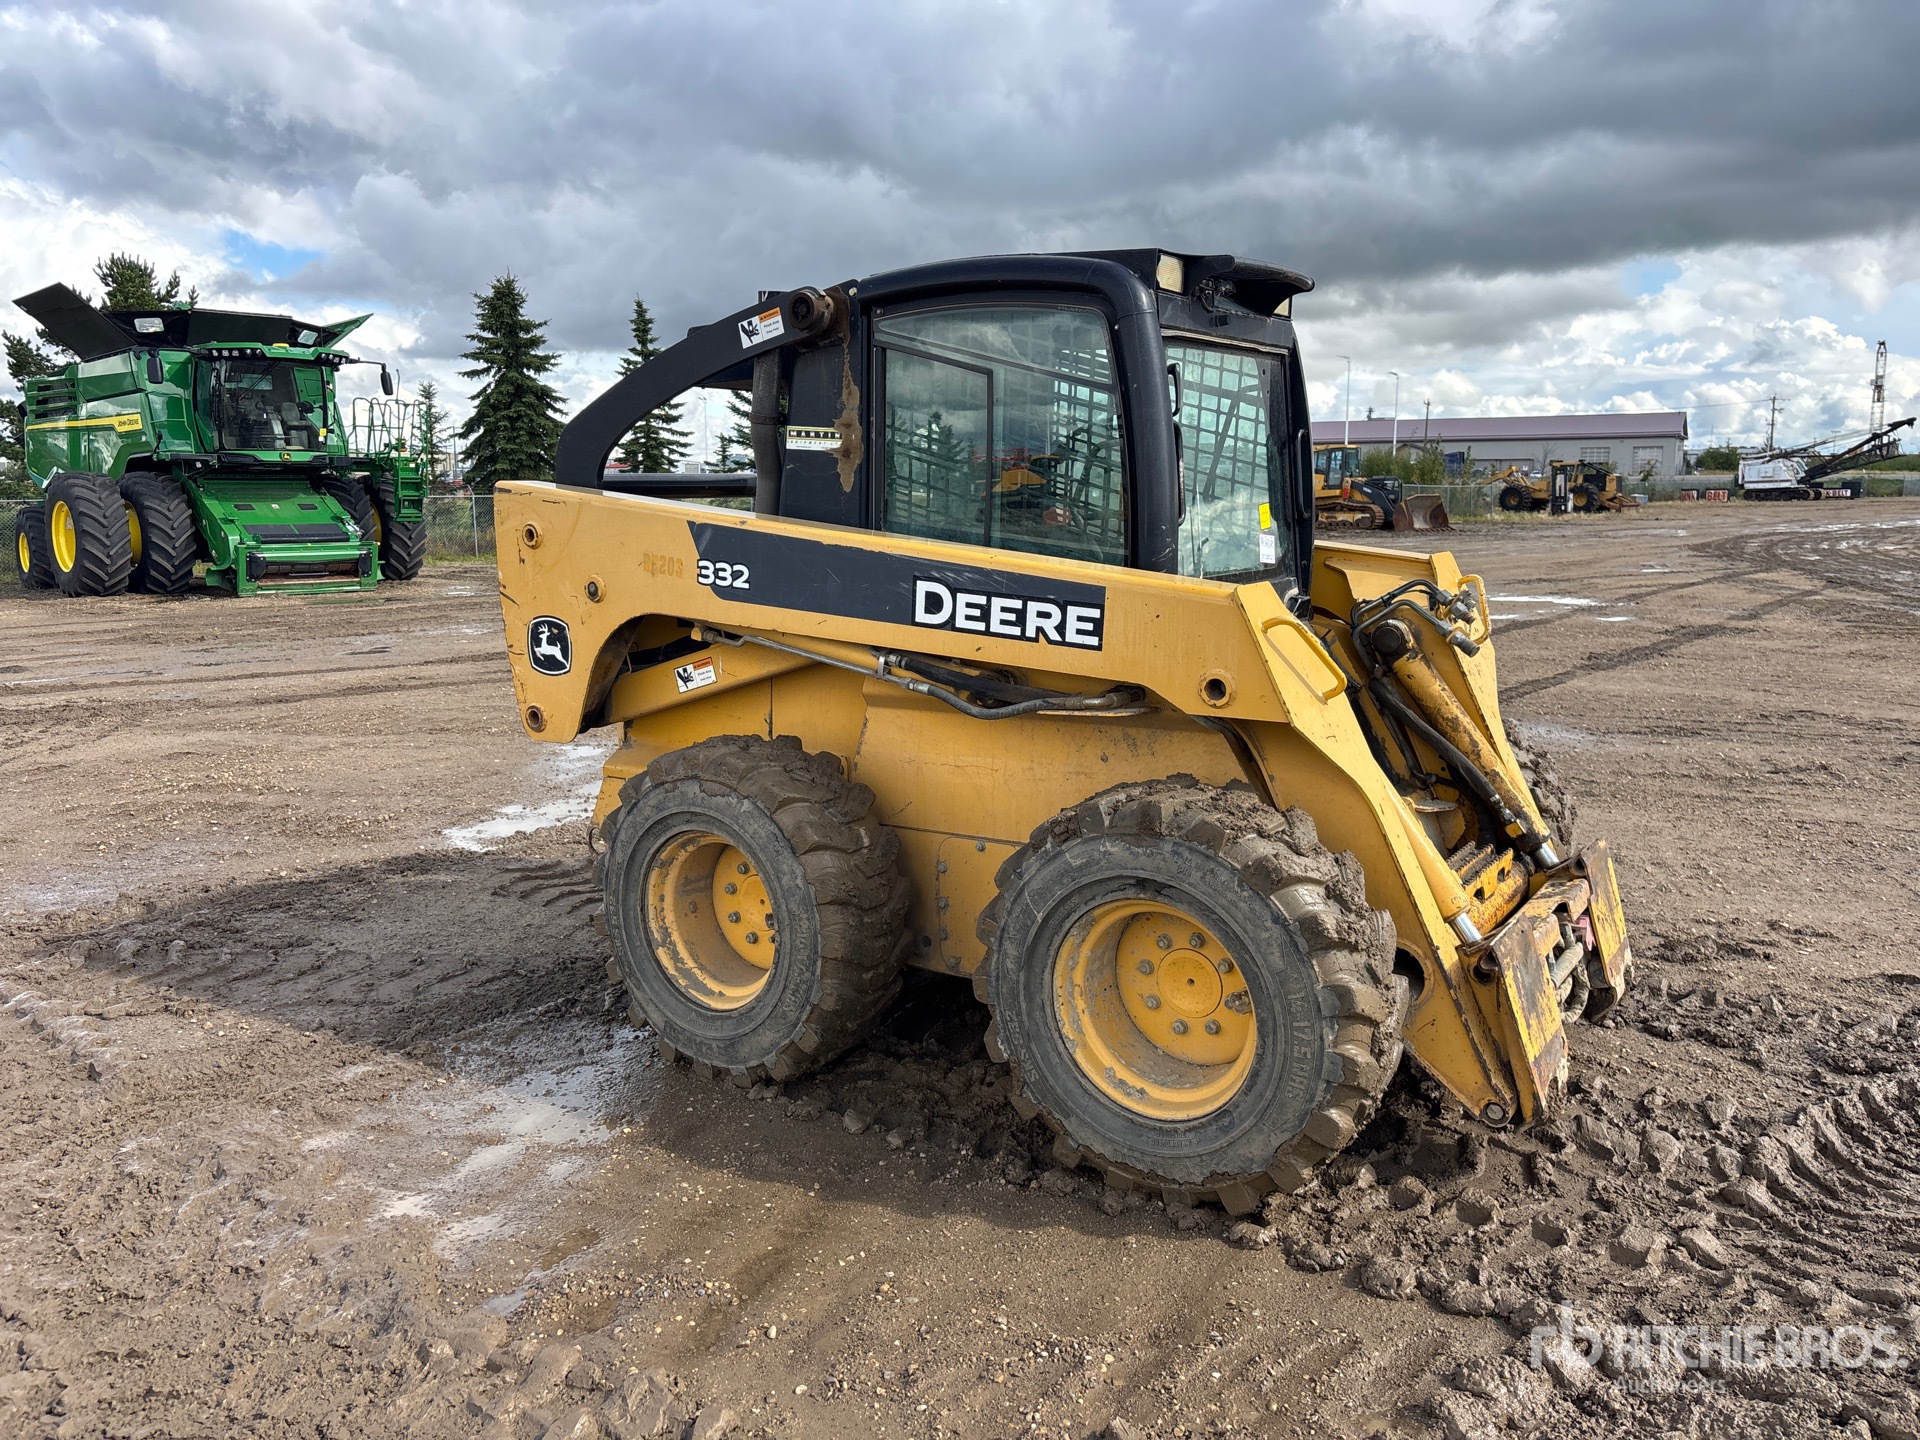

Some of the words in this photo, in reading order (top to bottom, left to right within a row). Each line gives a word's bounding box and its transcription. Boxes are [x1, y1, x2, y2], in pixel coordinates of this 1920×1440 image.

[790, 430, 840, 439] MARTIN
[1707, 491, 1728, 501] BELT
[697, 559, 751, 590] 332
[914, 579, 1101, 646] DEERE
